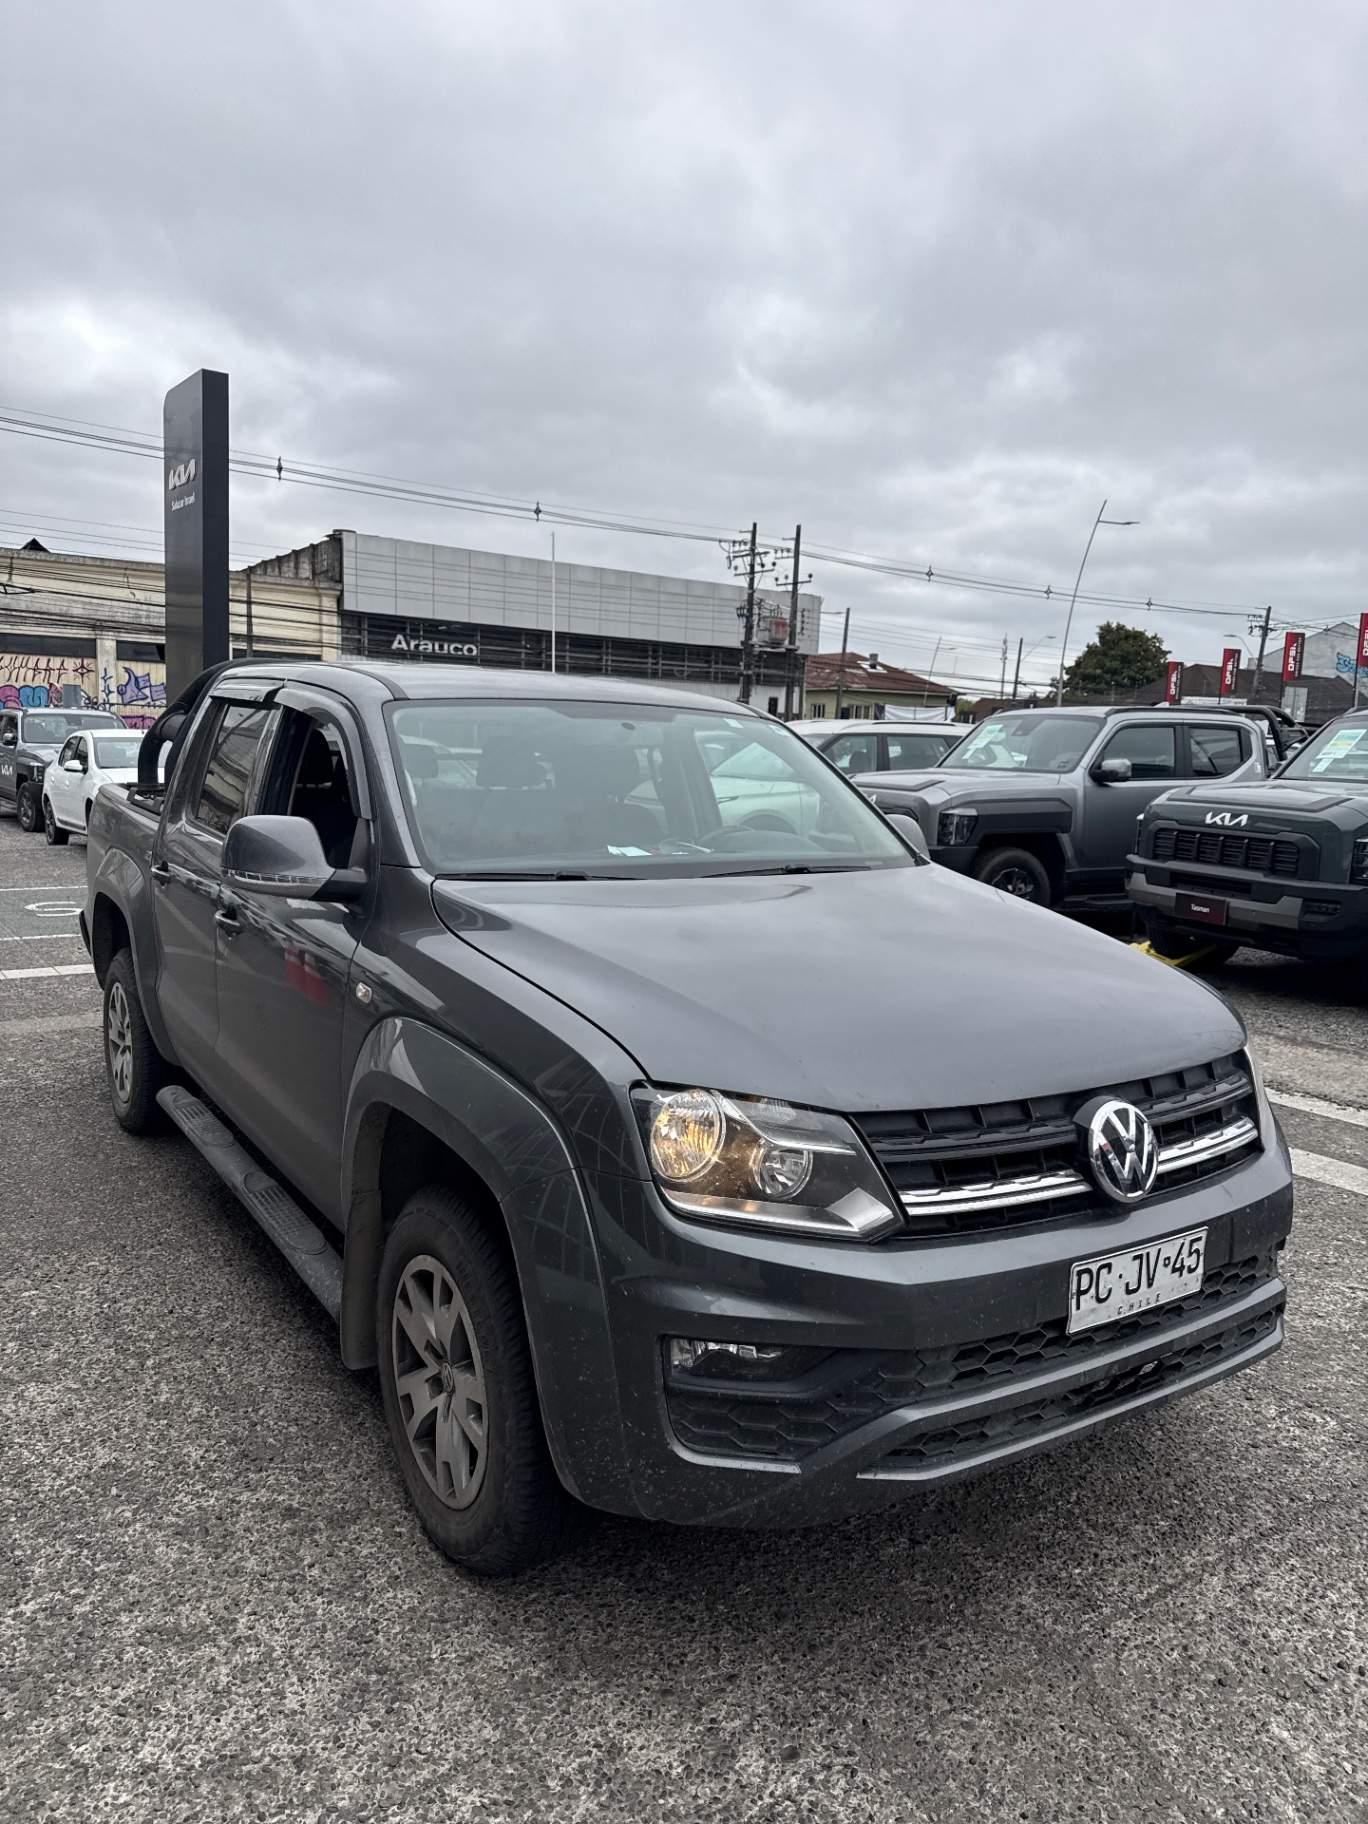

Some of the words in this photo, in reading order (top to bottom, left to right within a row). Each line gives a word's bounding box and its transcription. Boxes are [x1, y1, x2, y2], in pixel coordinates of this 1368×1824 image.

[168, 458, 196, 490] KIA
[391, 633, 478, 656] Arauco
[1204, 811, 1249, 827] KIA
[1190, 903, 1210, 913] Tasman
